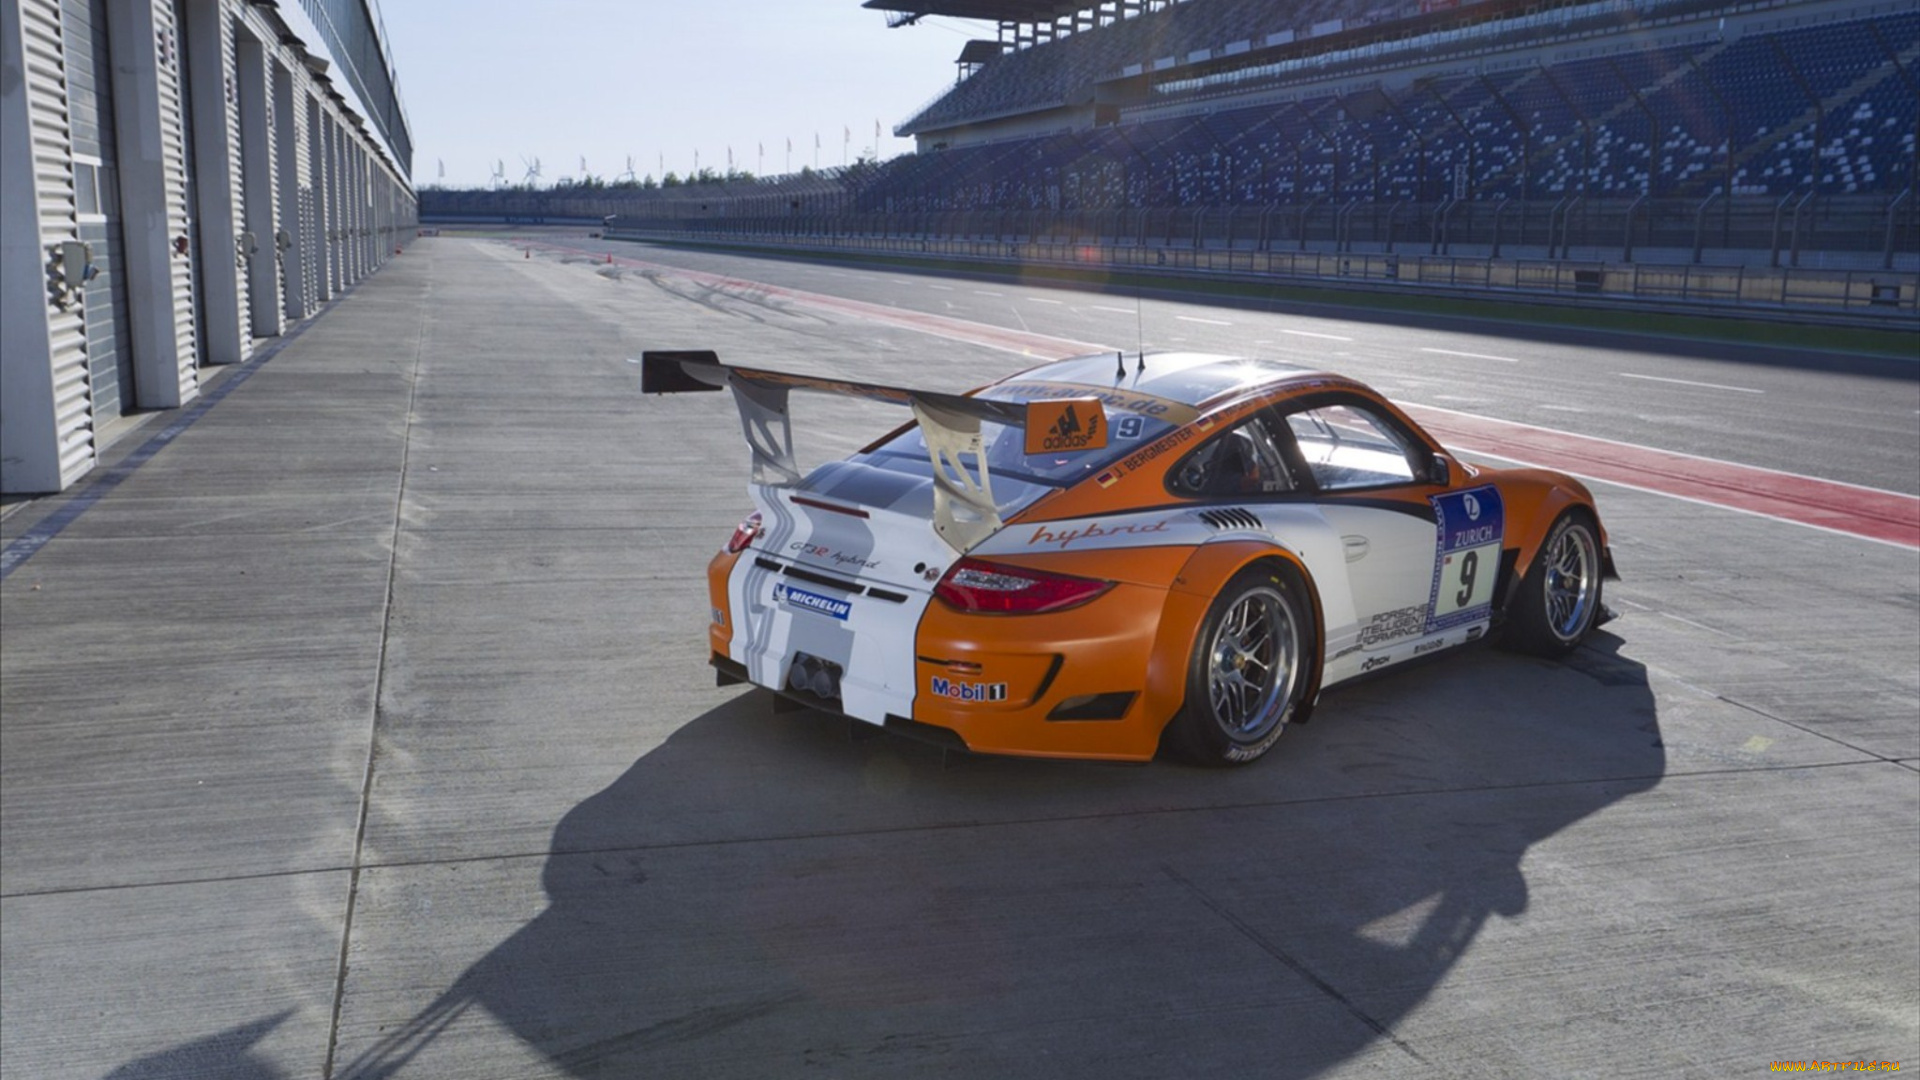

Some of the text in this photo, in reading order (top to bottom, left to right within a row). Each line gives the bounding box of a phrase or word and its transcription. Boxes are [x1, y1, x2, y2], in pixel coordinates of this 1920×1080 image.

[1119, 417, 1142, 438] 9
[1043, 432, 1088, 450] adidas
[1125, 427, 1194, 472] BERGMEISTER
[1028, 520, 1170, 548] hybrid
[1455, 525, 1493, 547] ZURICH
[1456, 551, 1478, 608] 9
[789, 591, 848, 615] MICHELIN
[1372, 603, 1429, 623] PORSCHE
[932, 677, 984, 701] Mobil
